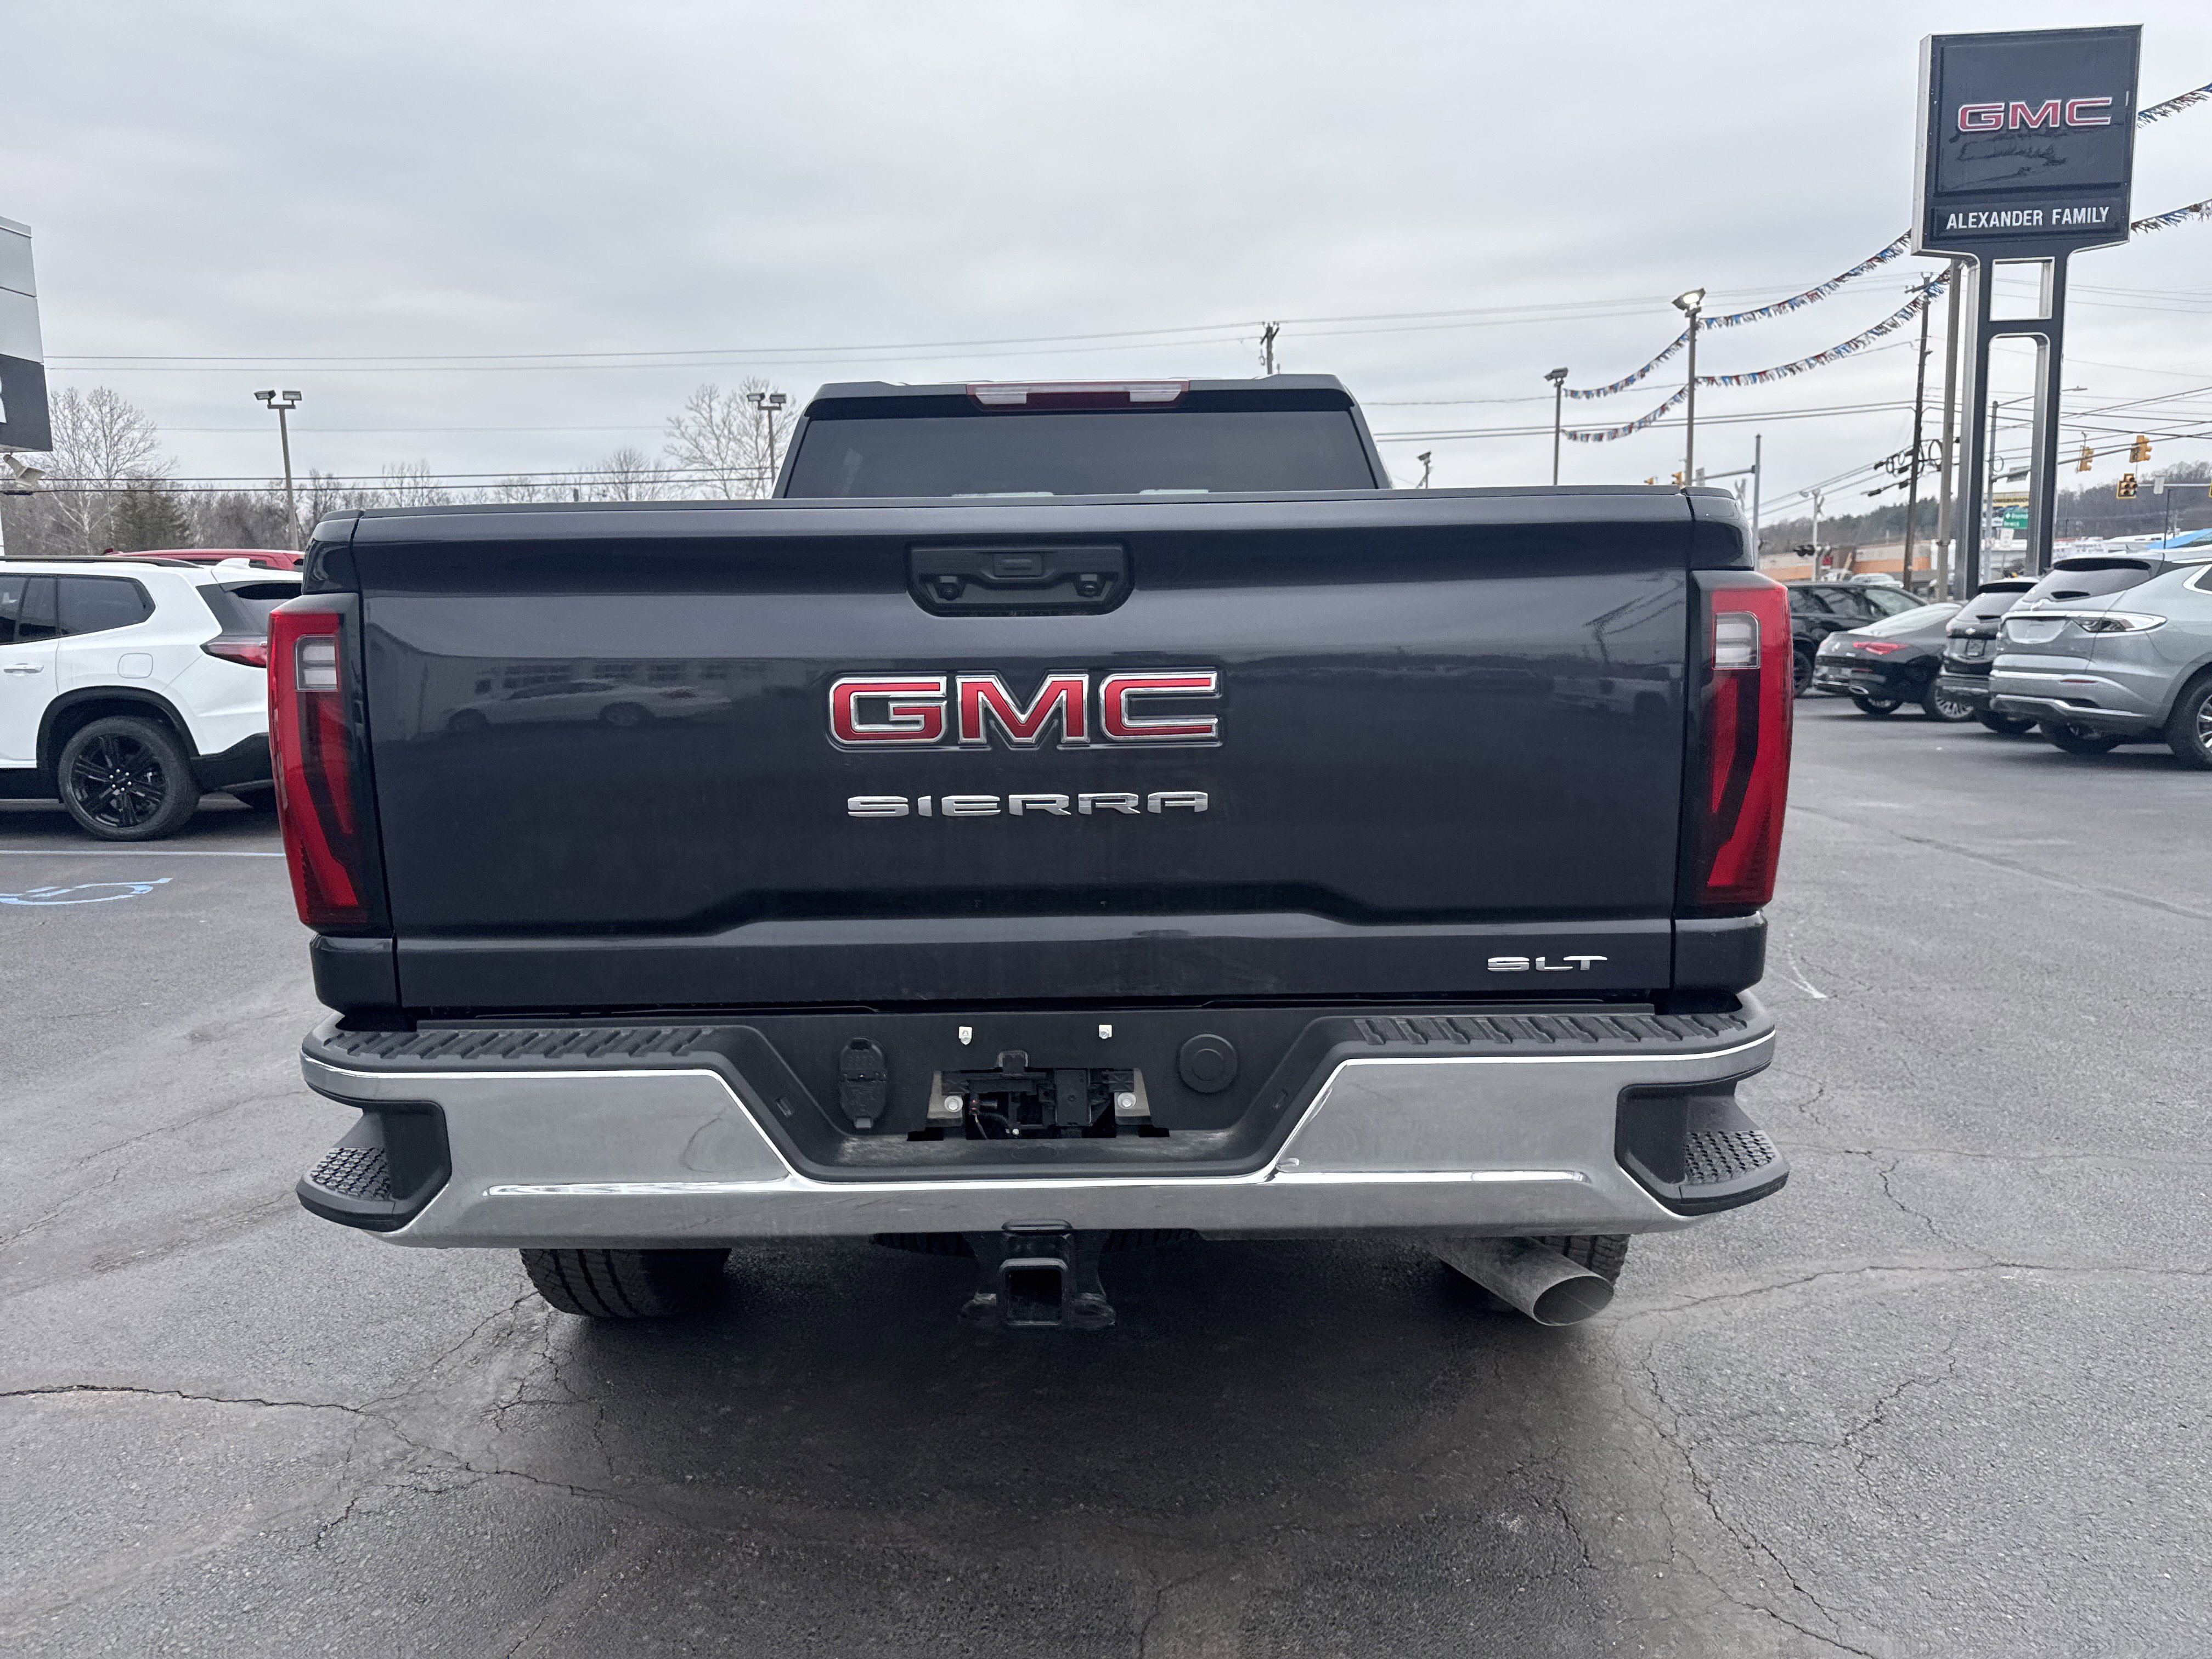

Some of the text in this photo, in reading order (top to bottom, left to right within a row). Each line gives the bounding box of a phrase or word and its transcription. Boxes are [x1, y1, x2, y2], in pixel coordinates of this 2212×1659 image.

[1957, 96, 2113, 132] GMC
[1946, 206, 2110, 230] ALEXANDER FAMILY
[828, 671, 1219, 745] GMC
[847, 791, 1209, 817] SIERRA
[1487, 955, 1608, 972] SLT
